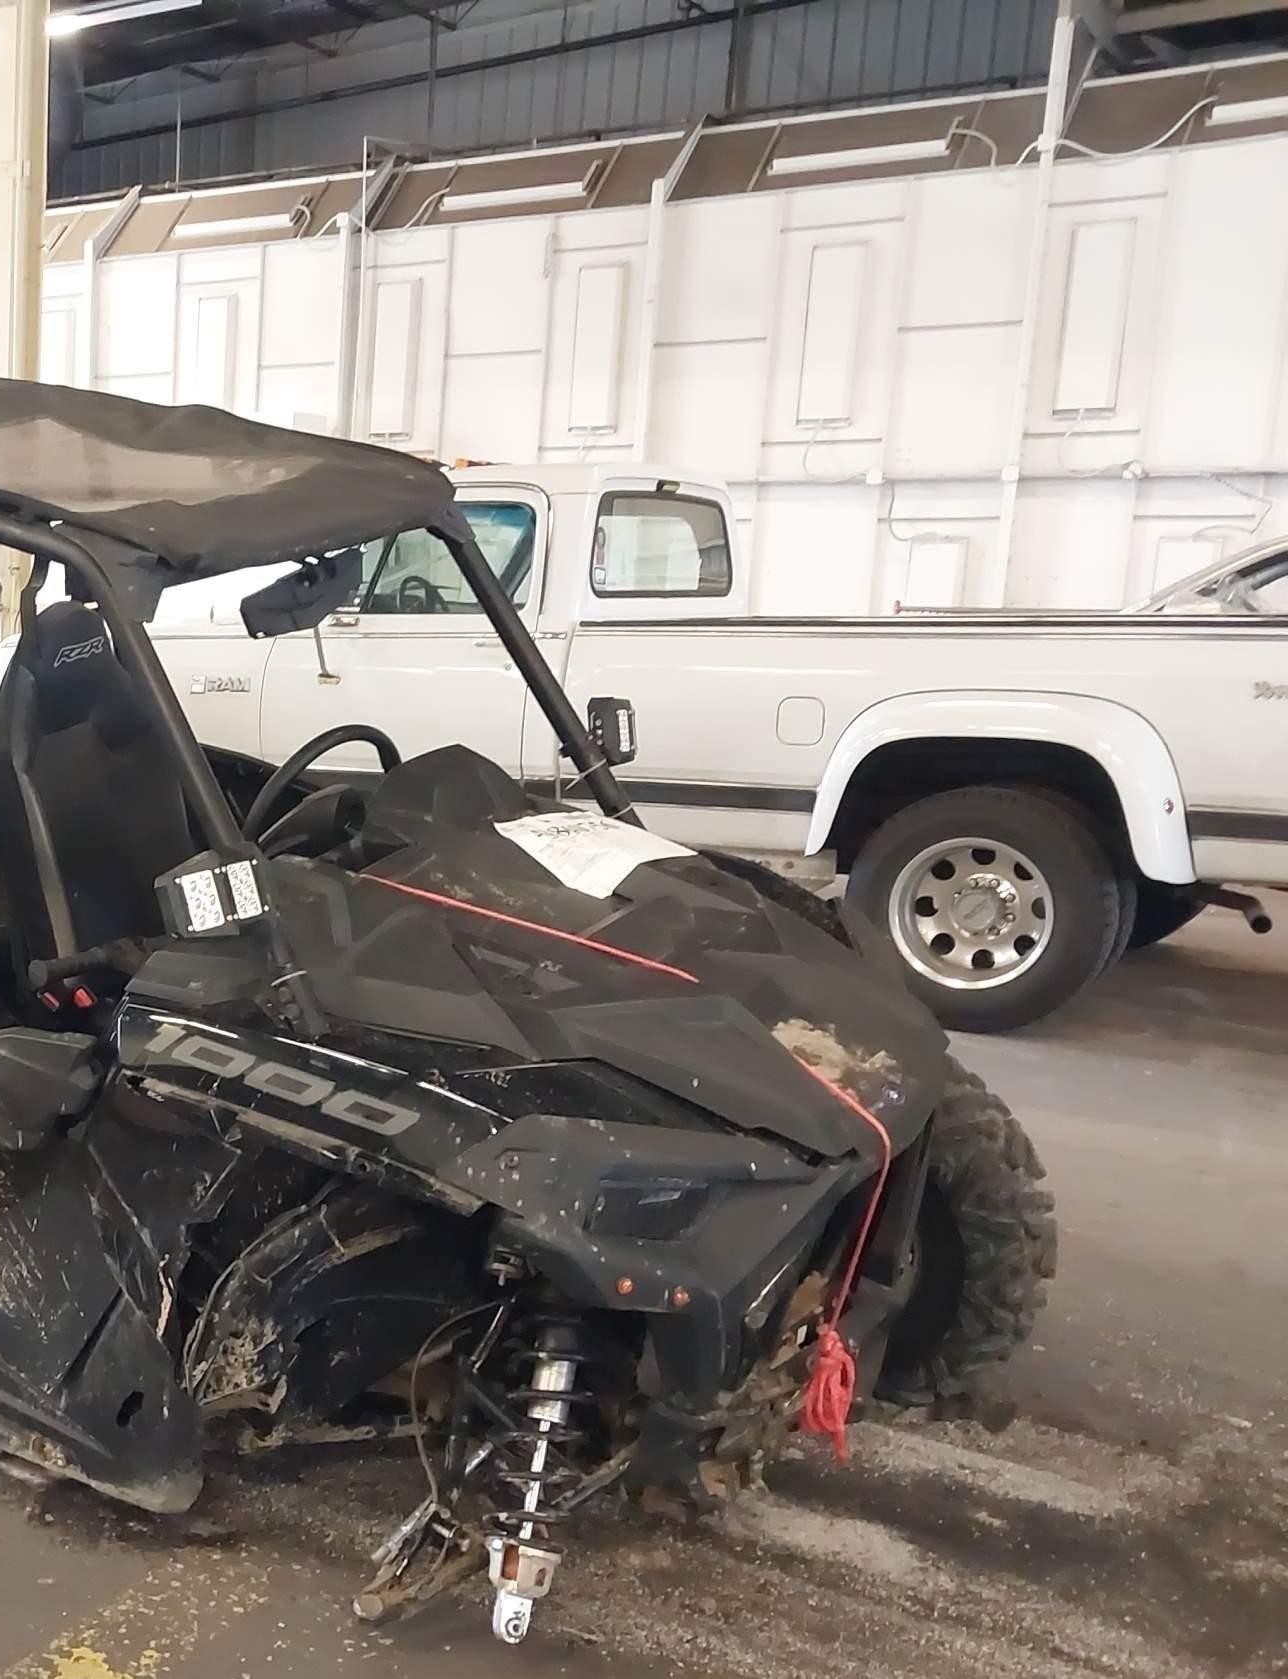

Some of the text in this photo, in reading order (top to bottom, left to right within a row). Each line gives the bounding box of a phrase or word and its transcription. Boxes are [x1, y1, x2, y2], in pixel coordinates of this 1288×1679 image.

[53, 636, 104, 668] RZR
[207, 676, 251, 693] RAM
[144, 1023, 420, 1136] 1000
